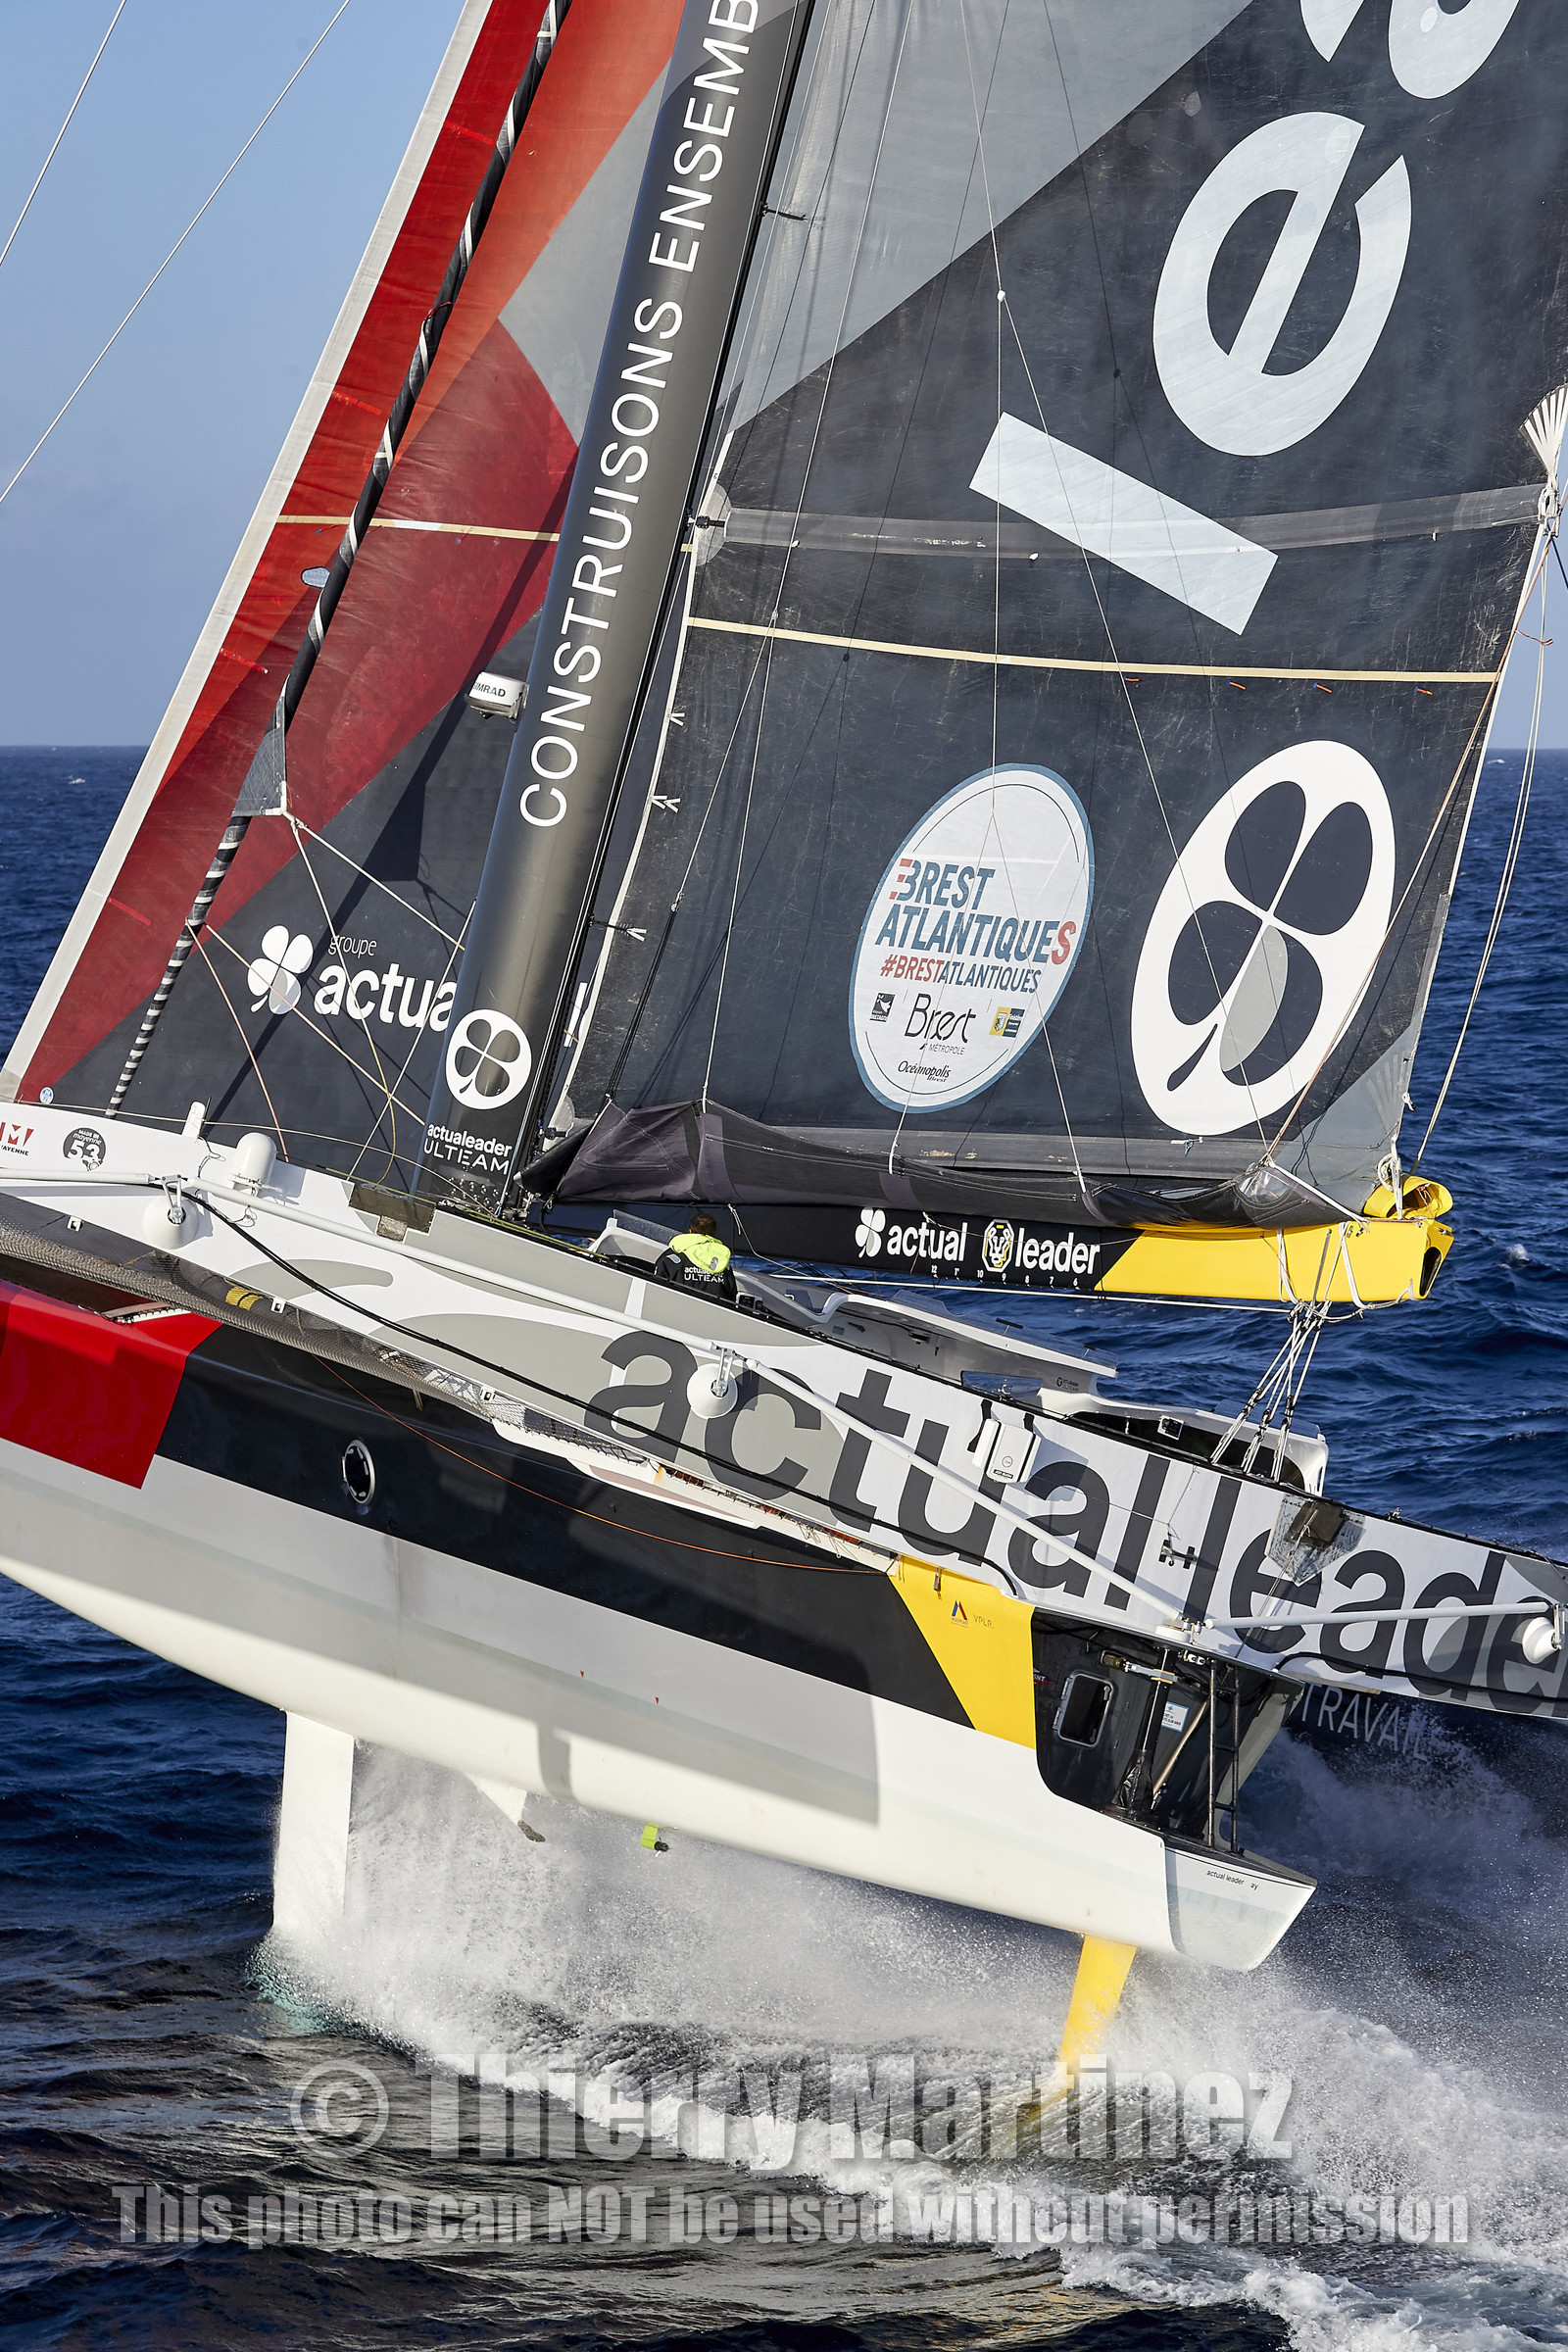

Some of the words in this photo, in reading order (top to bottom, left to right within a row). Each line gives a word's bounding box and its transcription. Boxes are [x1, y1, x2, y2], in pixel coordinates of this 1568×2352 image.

[519, 296, 683, 828] CONSTRUISONS
[648, 0, 760, 272] ENSEMB
[889, 858, 996, 910] BREST
[327, 934, 377, 959] groupe
[874, 903, 1077, 965] ATLANTIQUES
[880, 954, 1042, 994] #BRESTATLANTIQUES
[904, 993, 977, 1044] Brest
[1, 1145, 29, 1156] AYENNE
[67, 1139, 101, 1160] 53
[427, 1123, 513, 1157] actualeader
[886, 1221, 967, 1262] actual
[1015, 1227, 1100, 1275] leader
[1002, 1273, 1006, 1282] 9
[1025, 1275, 1030, 1284] 8
[1049, 1276, 1054, 1285] 7
[1073, 1278, 1078, 1287] 6
[1206, 1870, 1226, 1880] actual
[1226, 1874, 1245, 1885] leader
